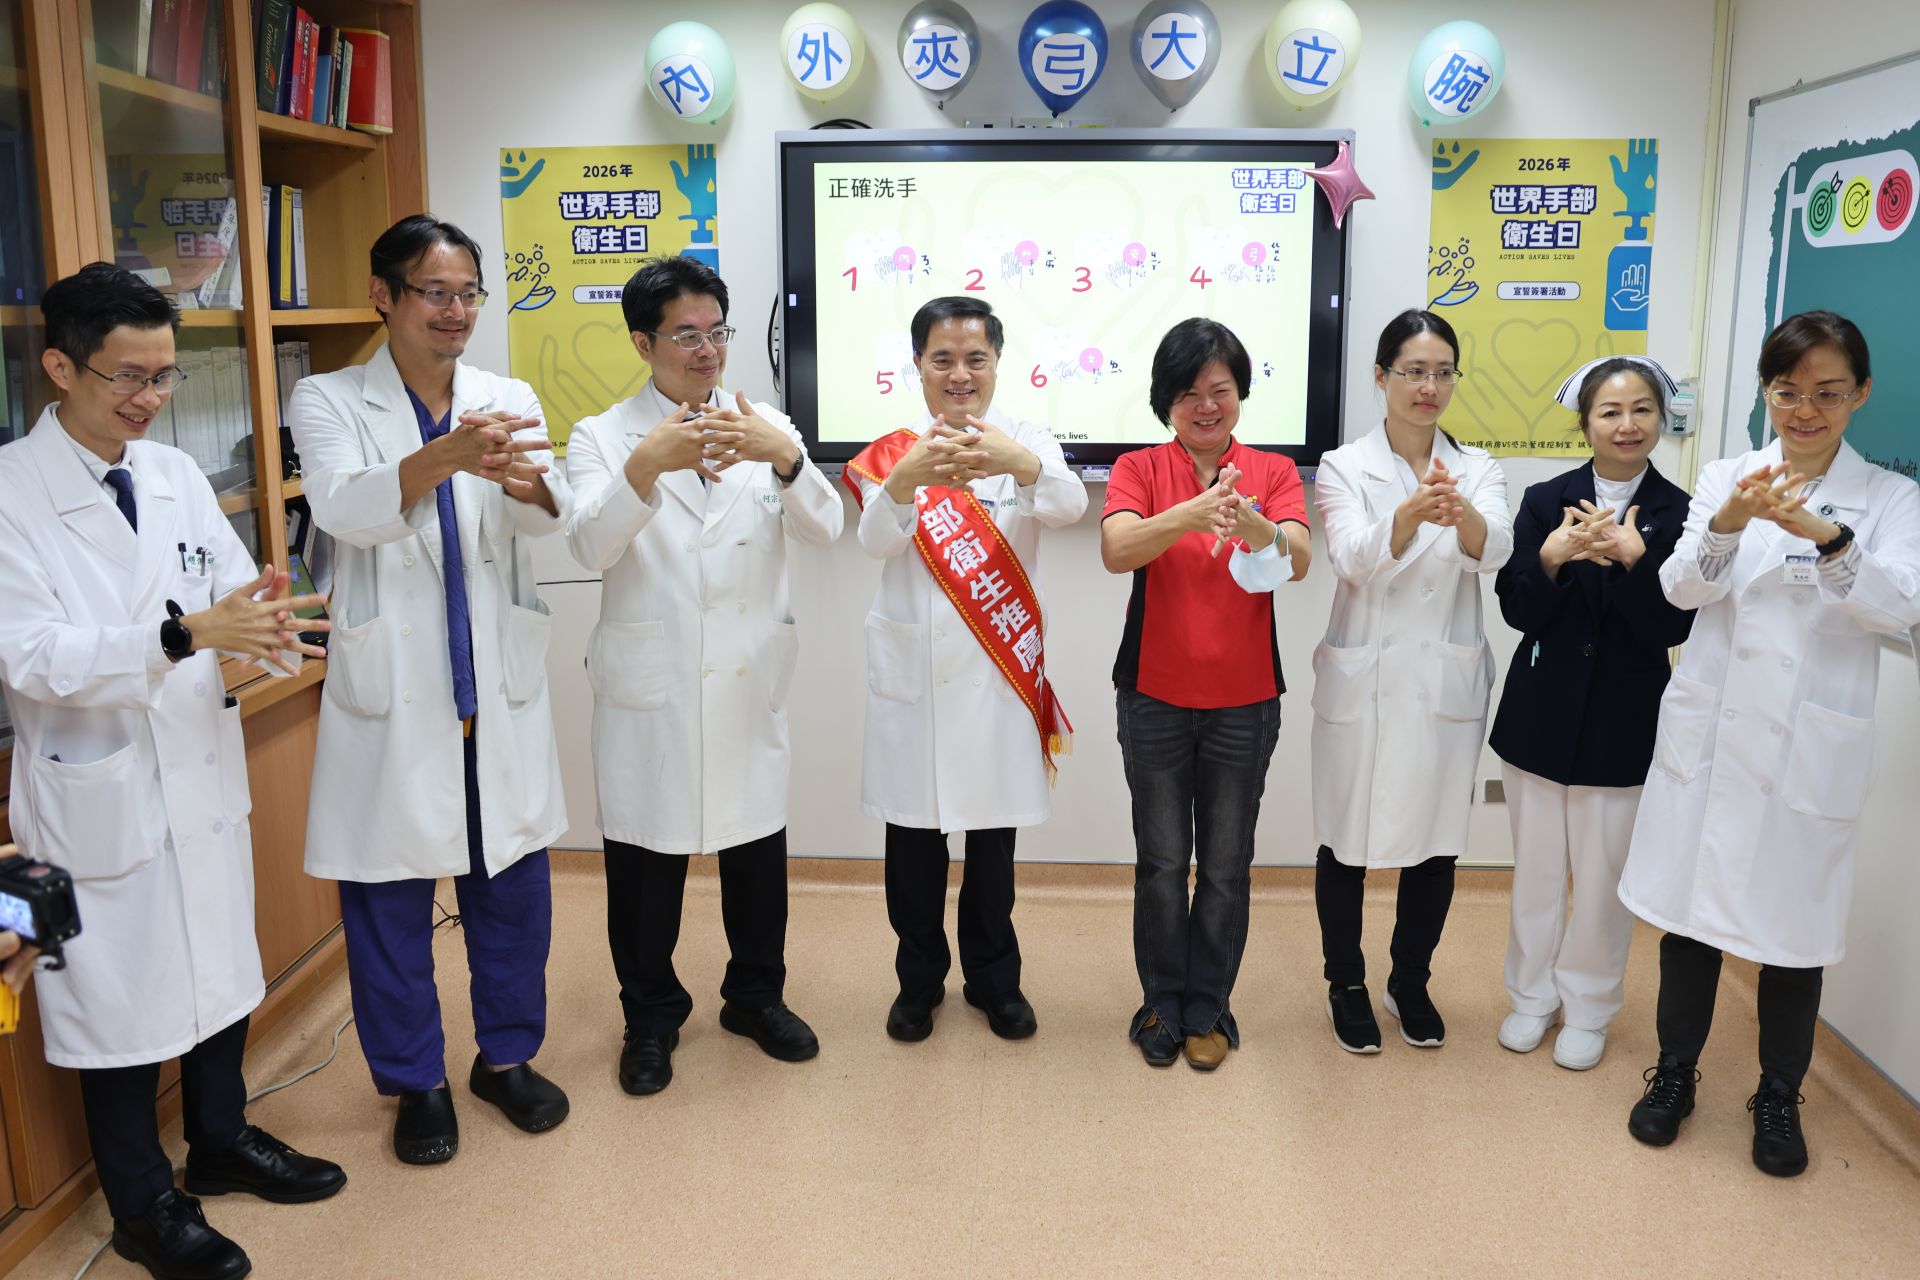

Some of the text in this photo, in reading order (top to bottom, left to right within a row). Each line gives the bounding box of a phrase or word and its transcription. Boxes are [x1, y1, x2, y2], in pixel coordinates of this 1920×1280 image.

[659, 20, 1491, 114] 內 外 夾 弓 大 立 腕
[583, 164, 633, 177] 2026年
[1518, 157, 1571, 171] 2026年
[828, 177, 917, 198] 正確洗手
[1232, 168, 1306, 189] 世界手部
[559, 190, 661, 220] 世界手部
[1240, 193, 1296, 213] 衛生日
[1490, 184, 1597, 214] 世界手部
[572, 225, 648, 254] 衛生日
[1501, 219, 1581, 249] 衛生日
[842, 266, 858, 291] 1
[964, 268, 986, 291] 2
[1072, 266, 1092, 292] 3
[1189, 266, 1212, 289] 4
[1513, 286, 1566, 296] 宣誓簽署活動
[876, 370, 894, 394] 5
[1031, 363, 1047, 388] 6
[1069, 431, 1088, 440] lives
[1893, 456, 1918, 478] Audit
